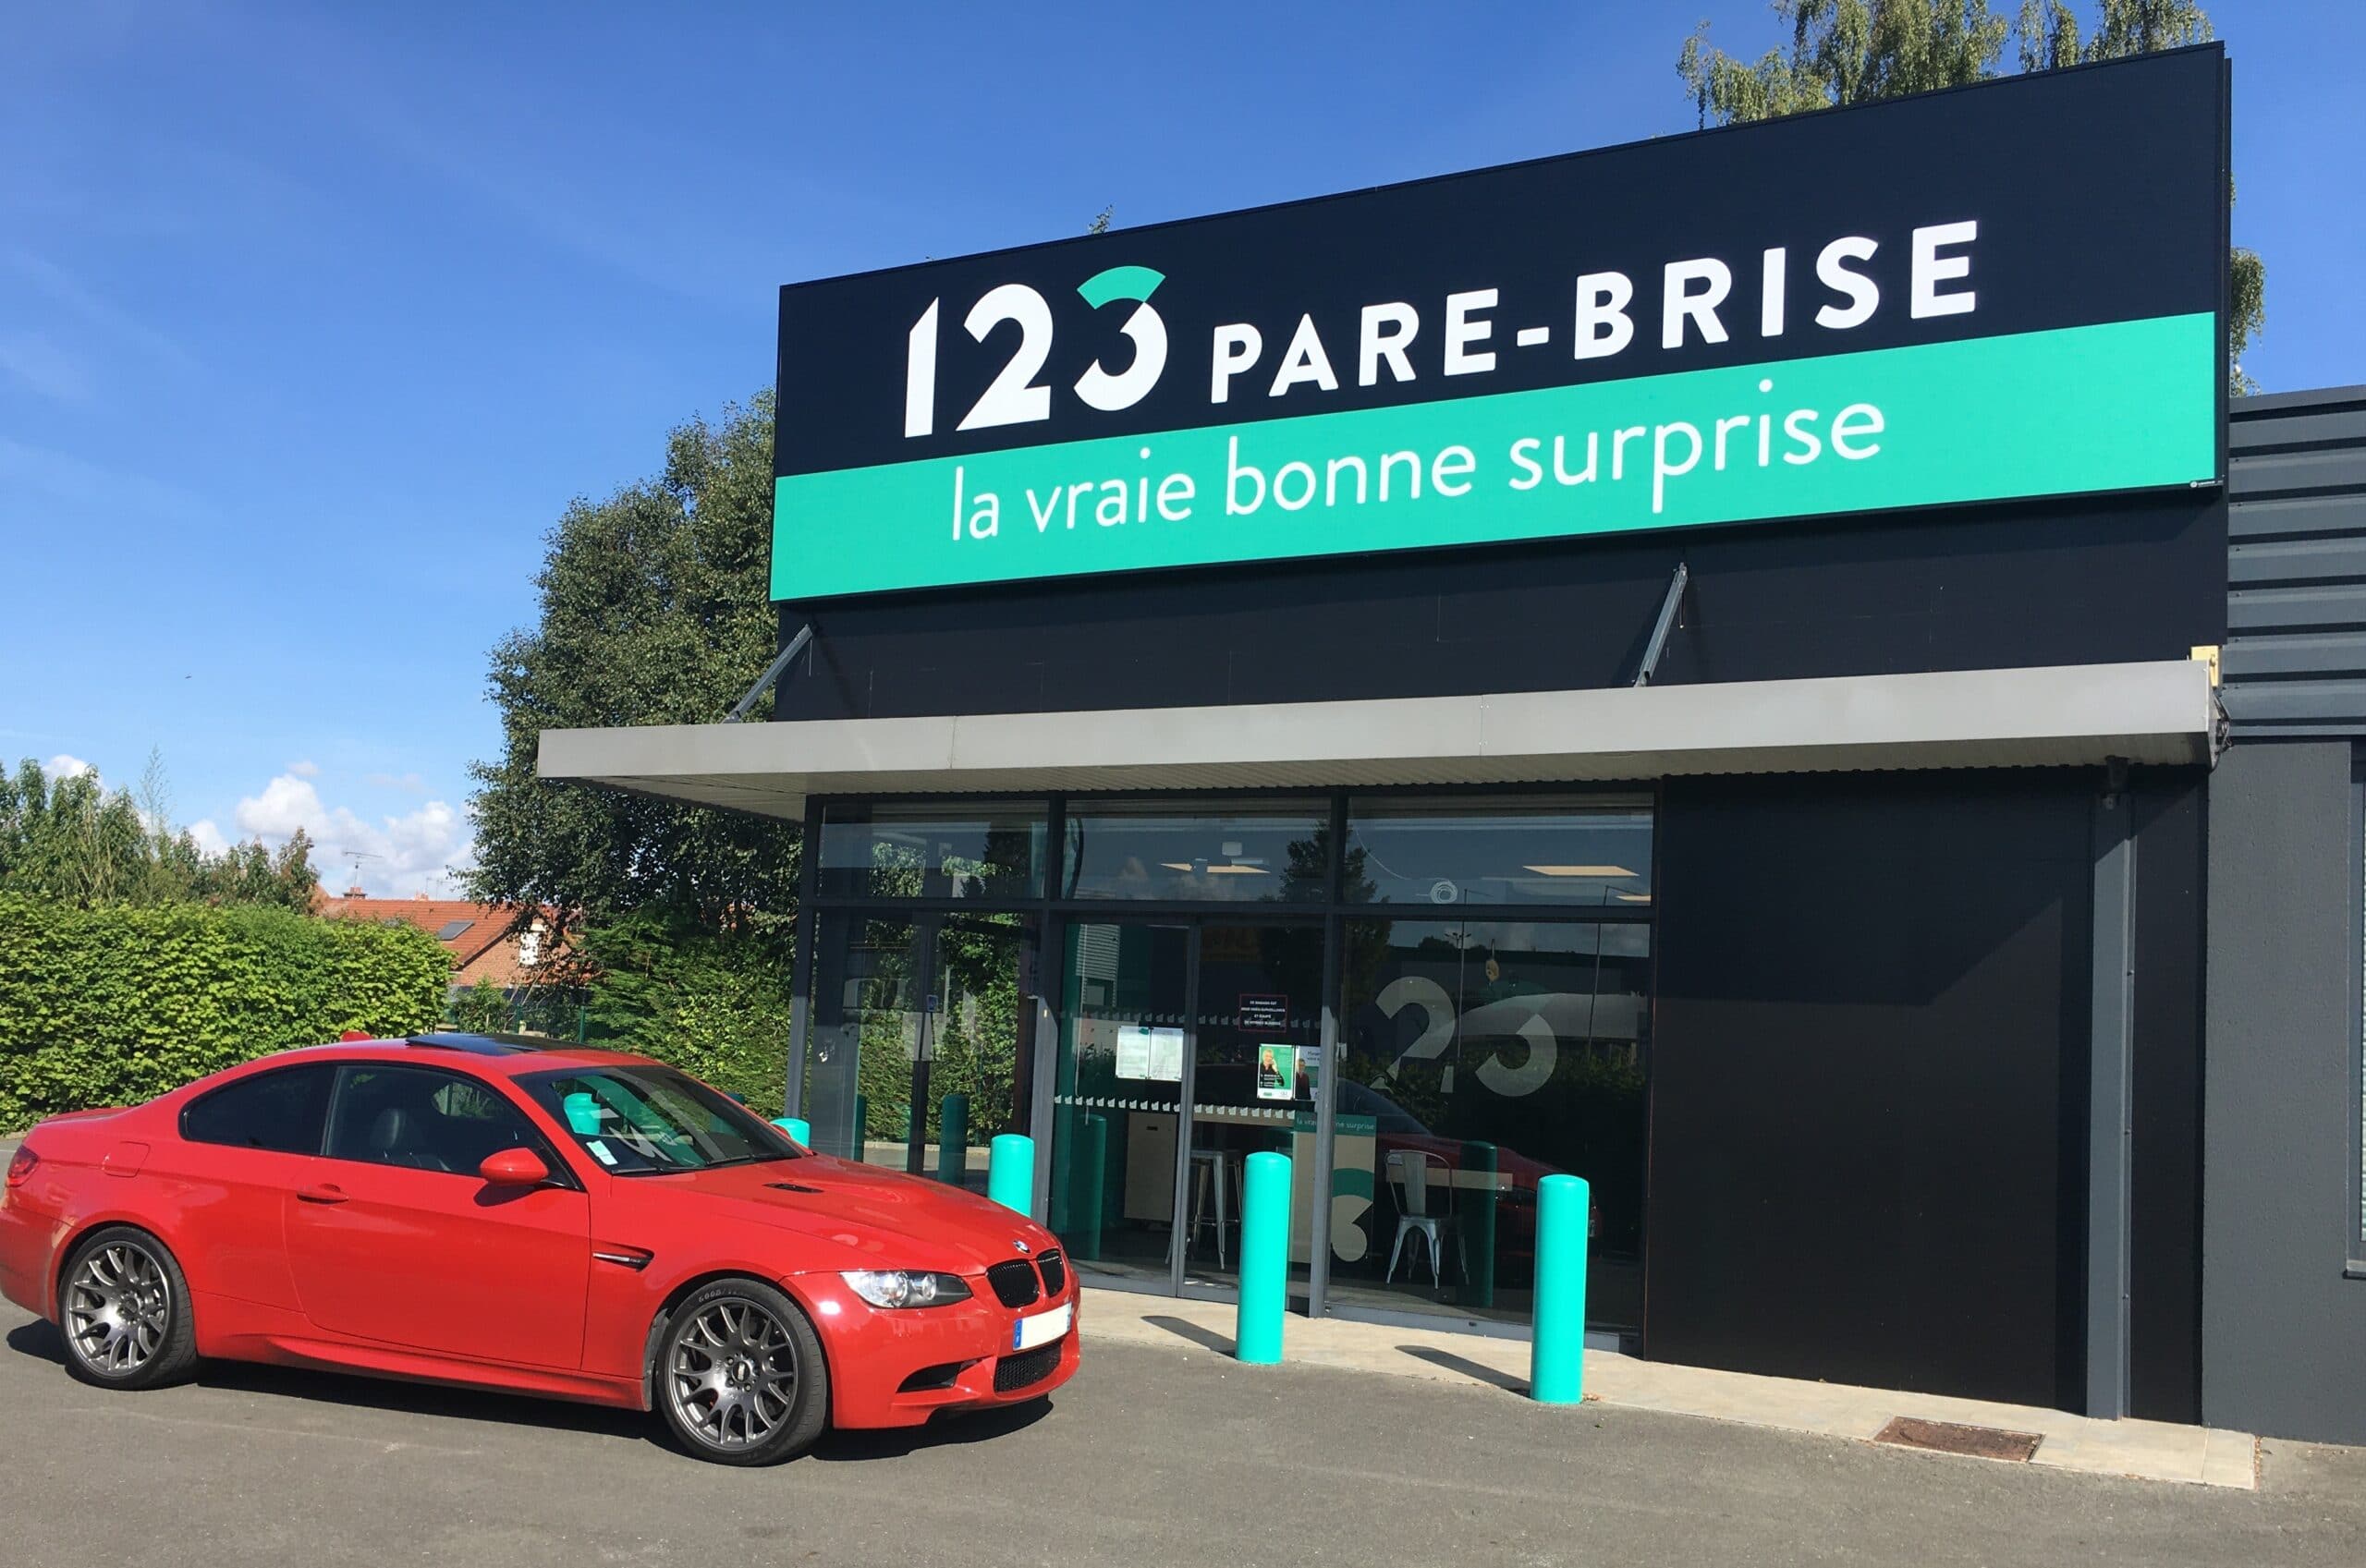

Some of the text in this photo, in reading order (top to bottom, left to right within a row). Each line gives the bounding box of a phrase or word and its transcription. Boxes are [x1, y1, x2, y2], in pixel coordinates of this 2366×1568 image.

[905, 220, 1978, 438] 123 PARE-BRISE
[952, 379, 1885, 541] la vraie bonne surprise
